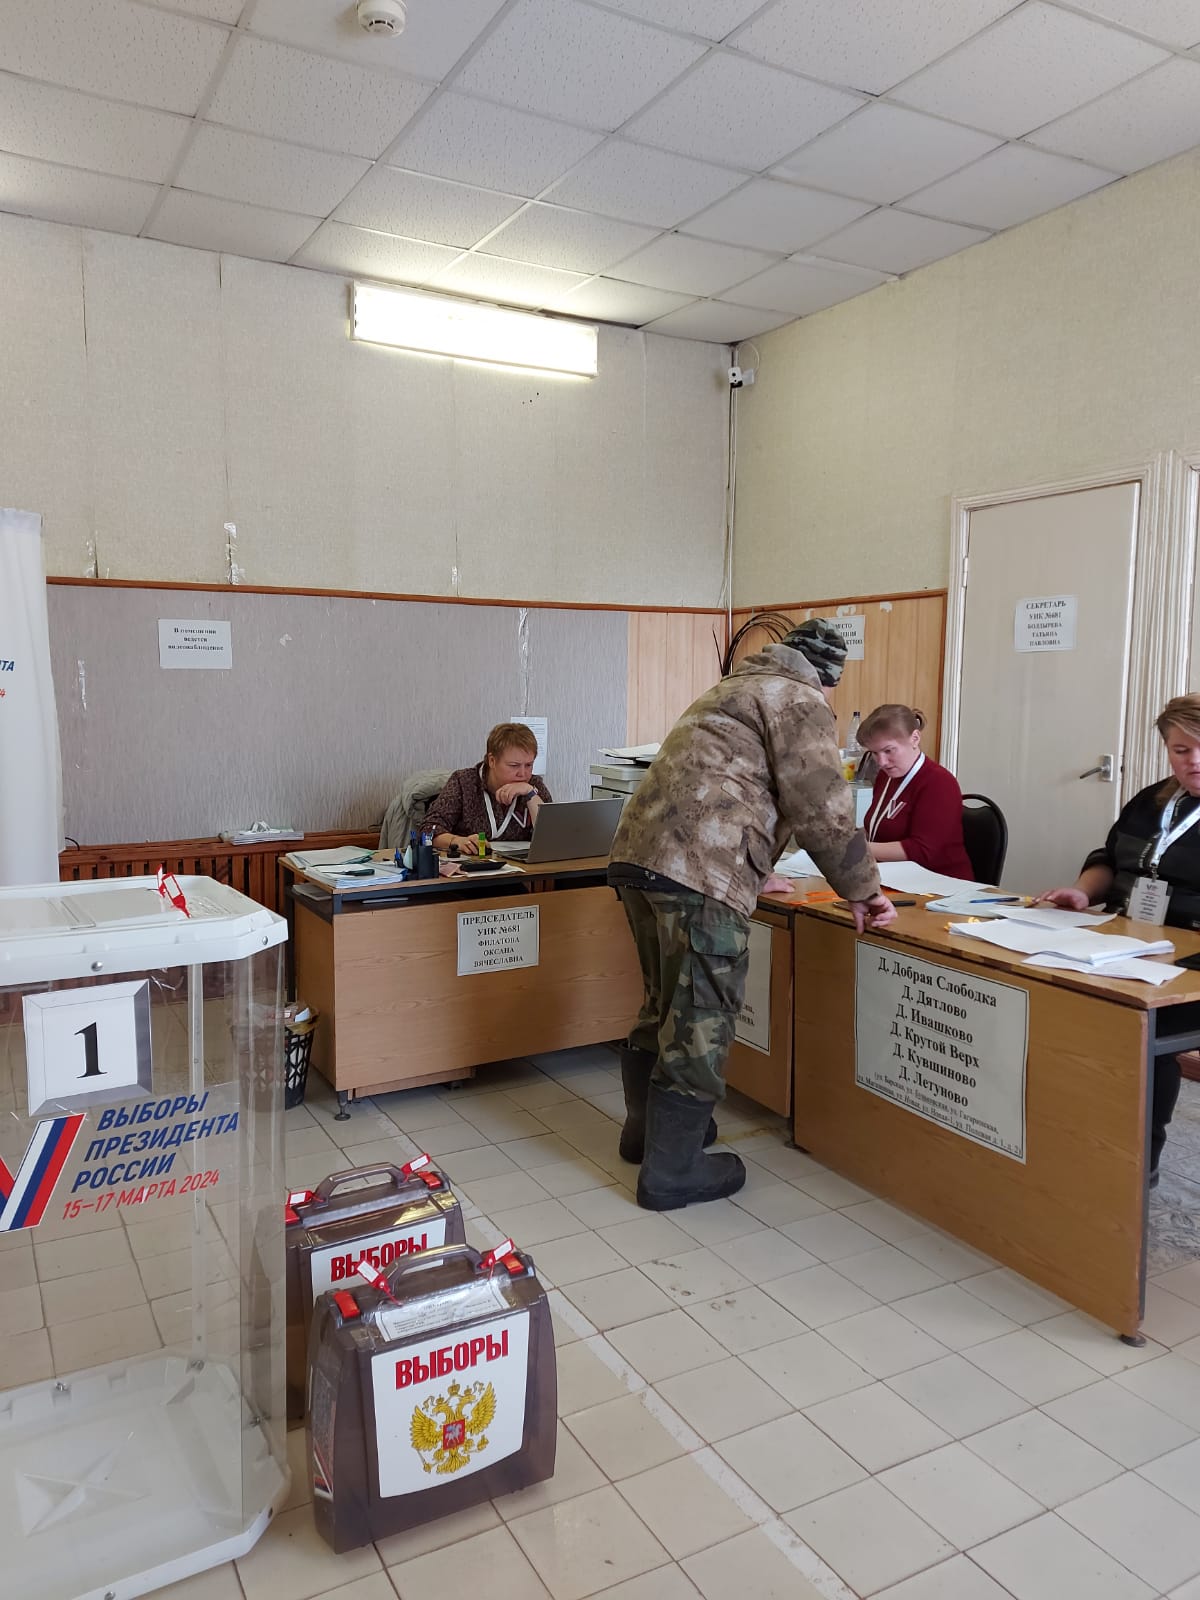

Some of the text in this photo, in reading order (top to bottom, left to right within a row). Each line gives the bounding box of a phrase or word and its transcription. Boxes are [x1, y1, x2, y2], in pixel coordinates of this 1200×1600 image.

[1026, 600, 1066, 610] СЕКРЕТАРЬ
[0, 660, 15, 671] ТА
[462, 911, 535, 926] ПРЕДСЕДАТЕЛЬ
[477, 924, 520, 936] УИК №681
[474, 956, 524, 968] ВЯЧЕСЛАВНА
[478, 937, 520, 947] ФИЛАТОВА
[483, 947, 515, 957] ОКСАНА
[878, 956, 997, 1007] Д. Добрая Слободка
[901, 985, 967, 1019] Д. Дятлово
[896, 1003, 973, 1043] Д. Ивашково
[74, 1021, 108, 1079] 1
[890, 1021, 980, 1068] Д. Крутой Верх
[893, 1042, 976, 1088] Д. Кувшиново
[899, 1065, 911, 1081] Д.
[913, 1071, 968, 1107] Летуново
[97, 1091, 209, 1131] ВЫБОРЫ
[84, 1112, 239, 1162] ПРЕЗИДЕНТА
[72, 1152, 177, 1193] РОССИИ
[115, 1178, 176, 1208] МАРТА
[179, 1169, 220, 1194] 2024
[395, 1329, 509, 1390] ВЫБОРЫ
